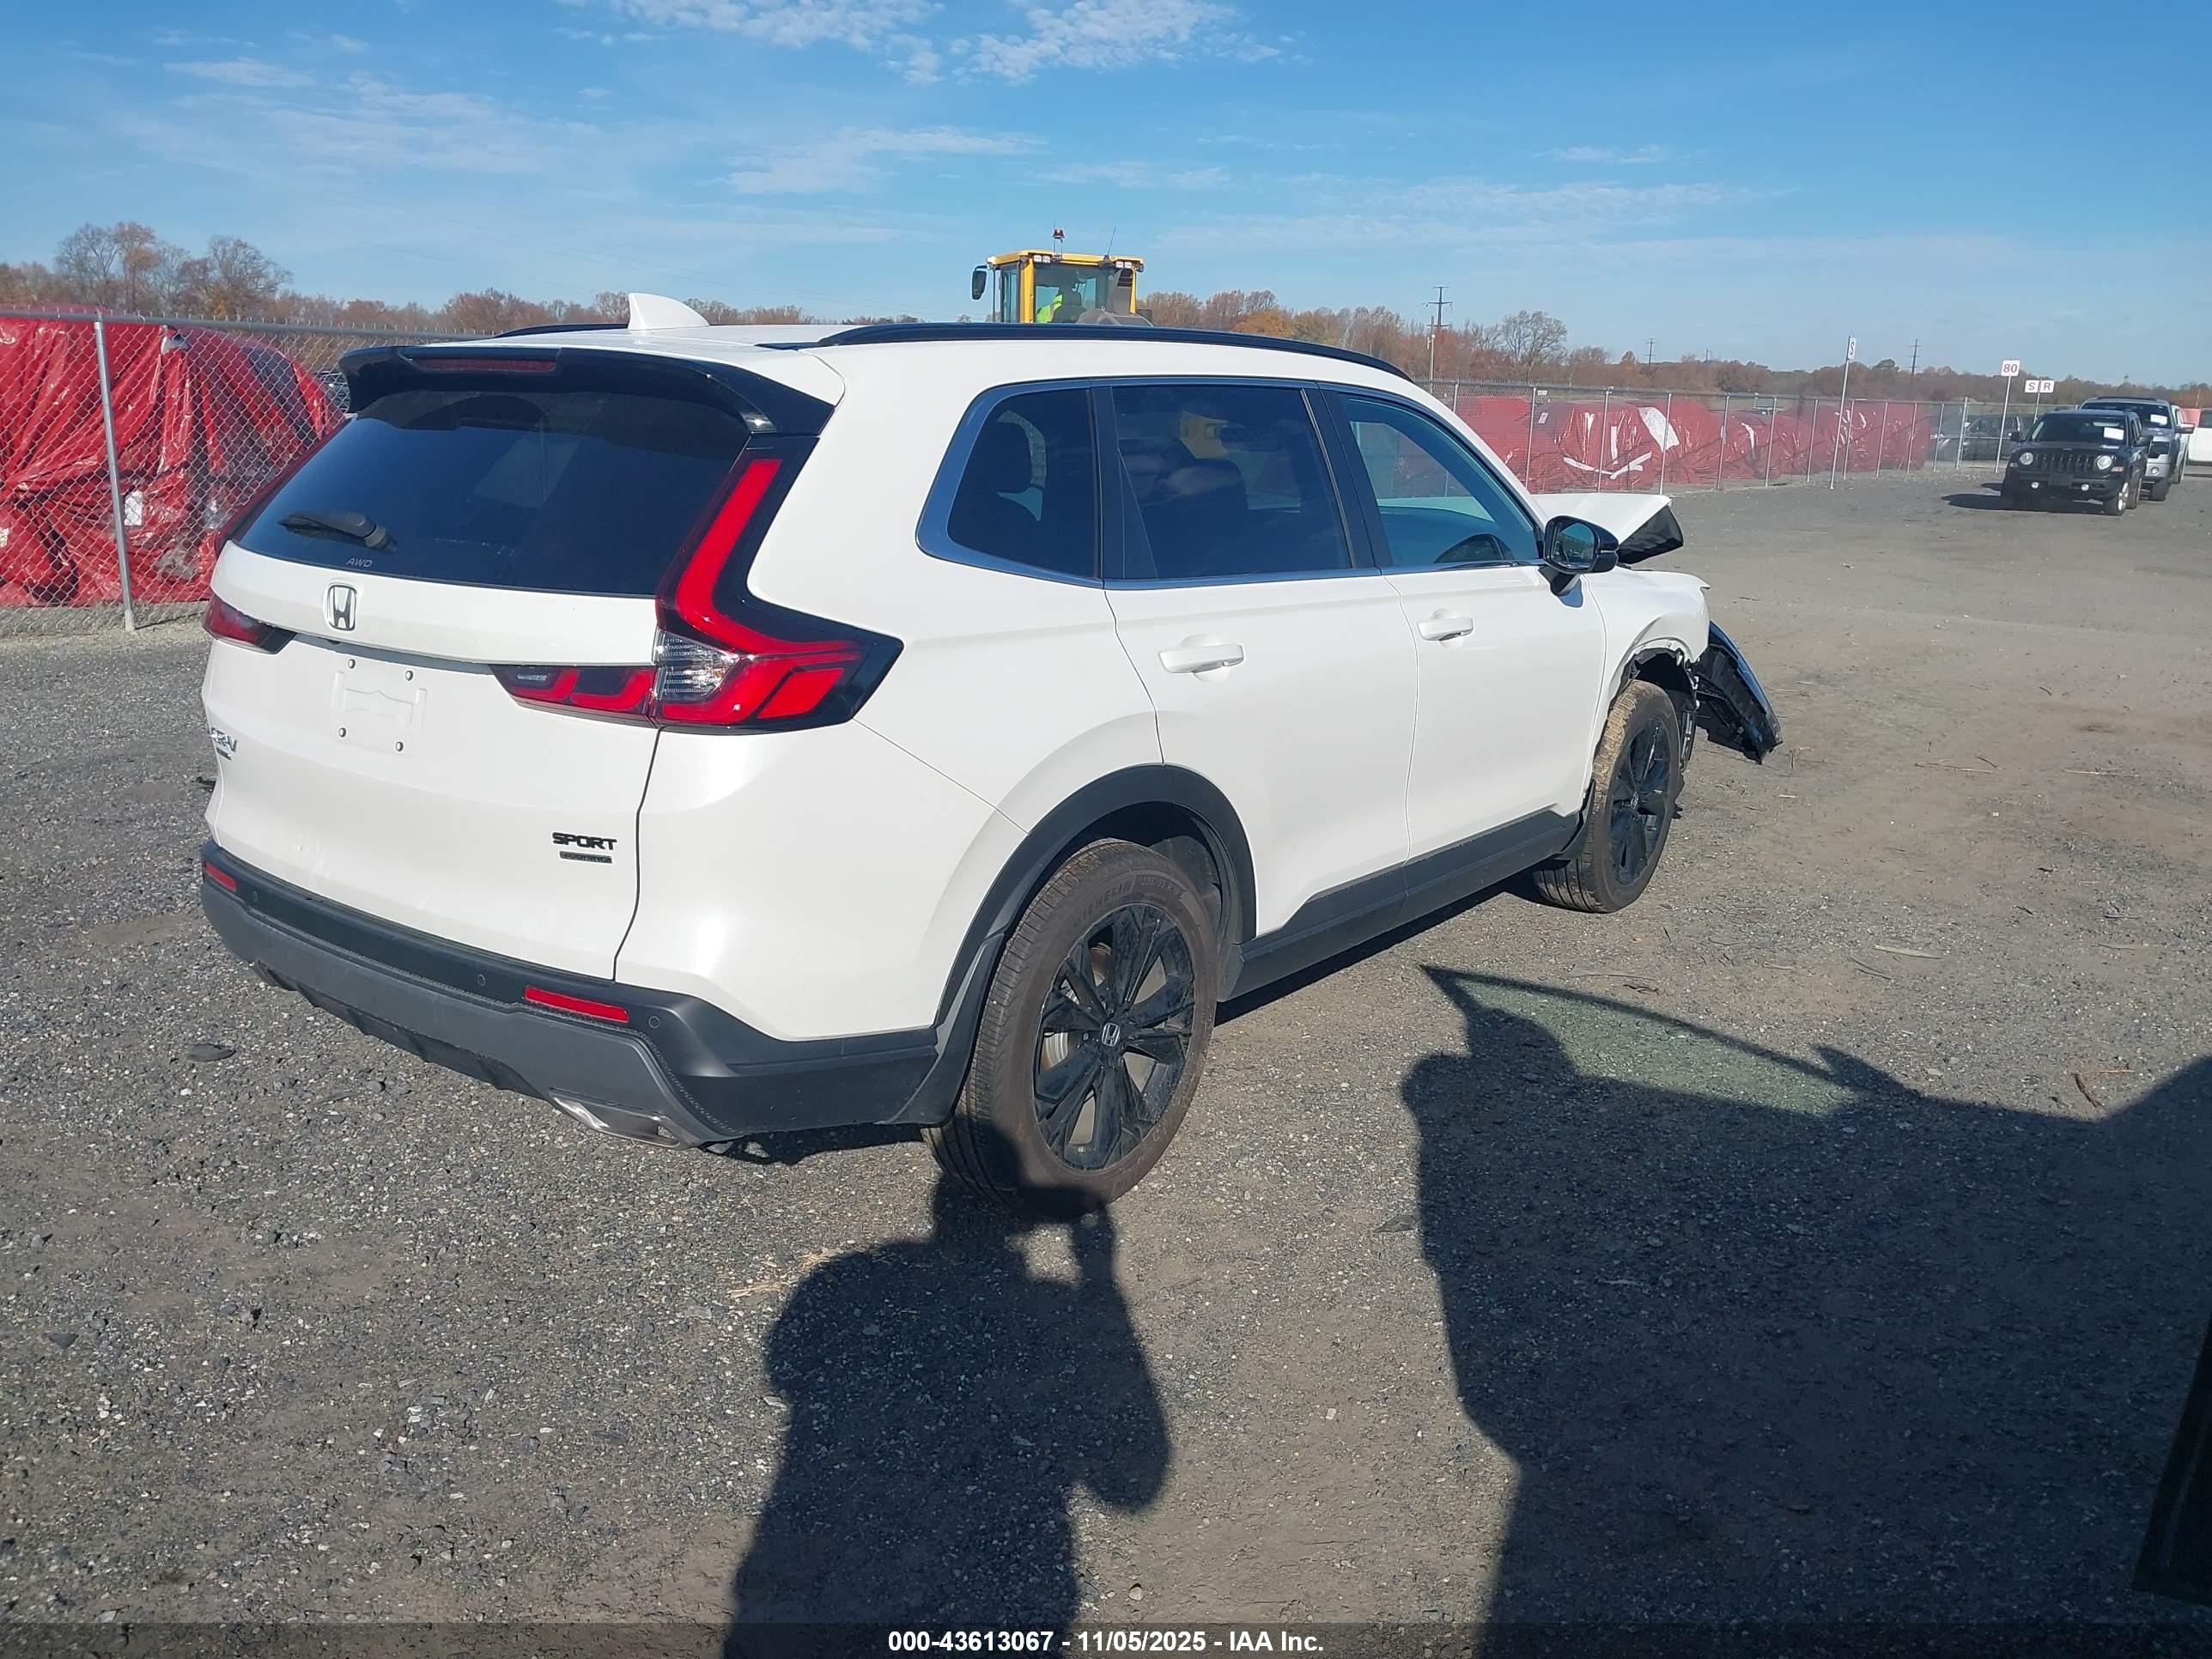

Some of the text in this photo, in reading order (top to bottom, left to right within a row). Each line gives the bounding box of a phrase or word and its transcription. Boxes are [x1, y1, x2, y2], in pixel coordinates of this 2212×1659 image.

[1850, 341, 1855, 356] S
[2002, 363, 2018, 374] 80
[2027, 381, 2051, 391] S R
[344, 556, 374, 568] AWD
[552, 831, 617, 850] SPORT
